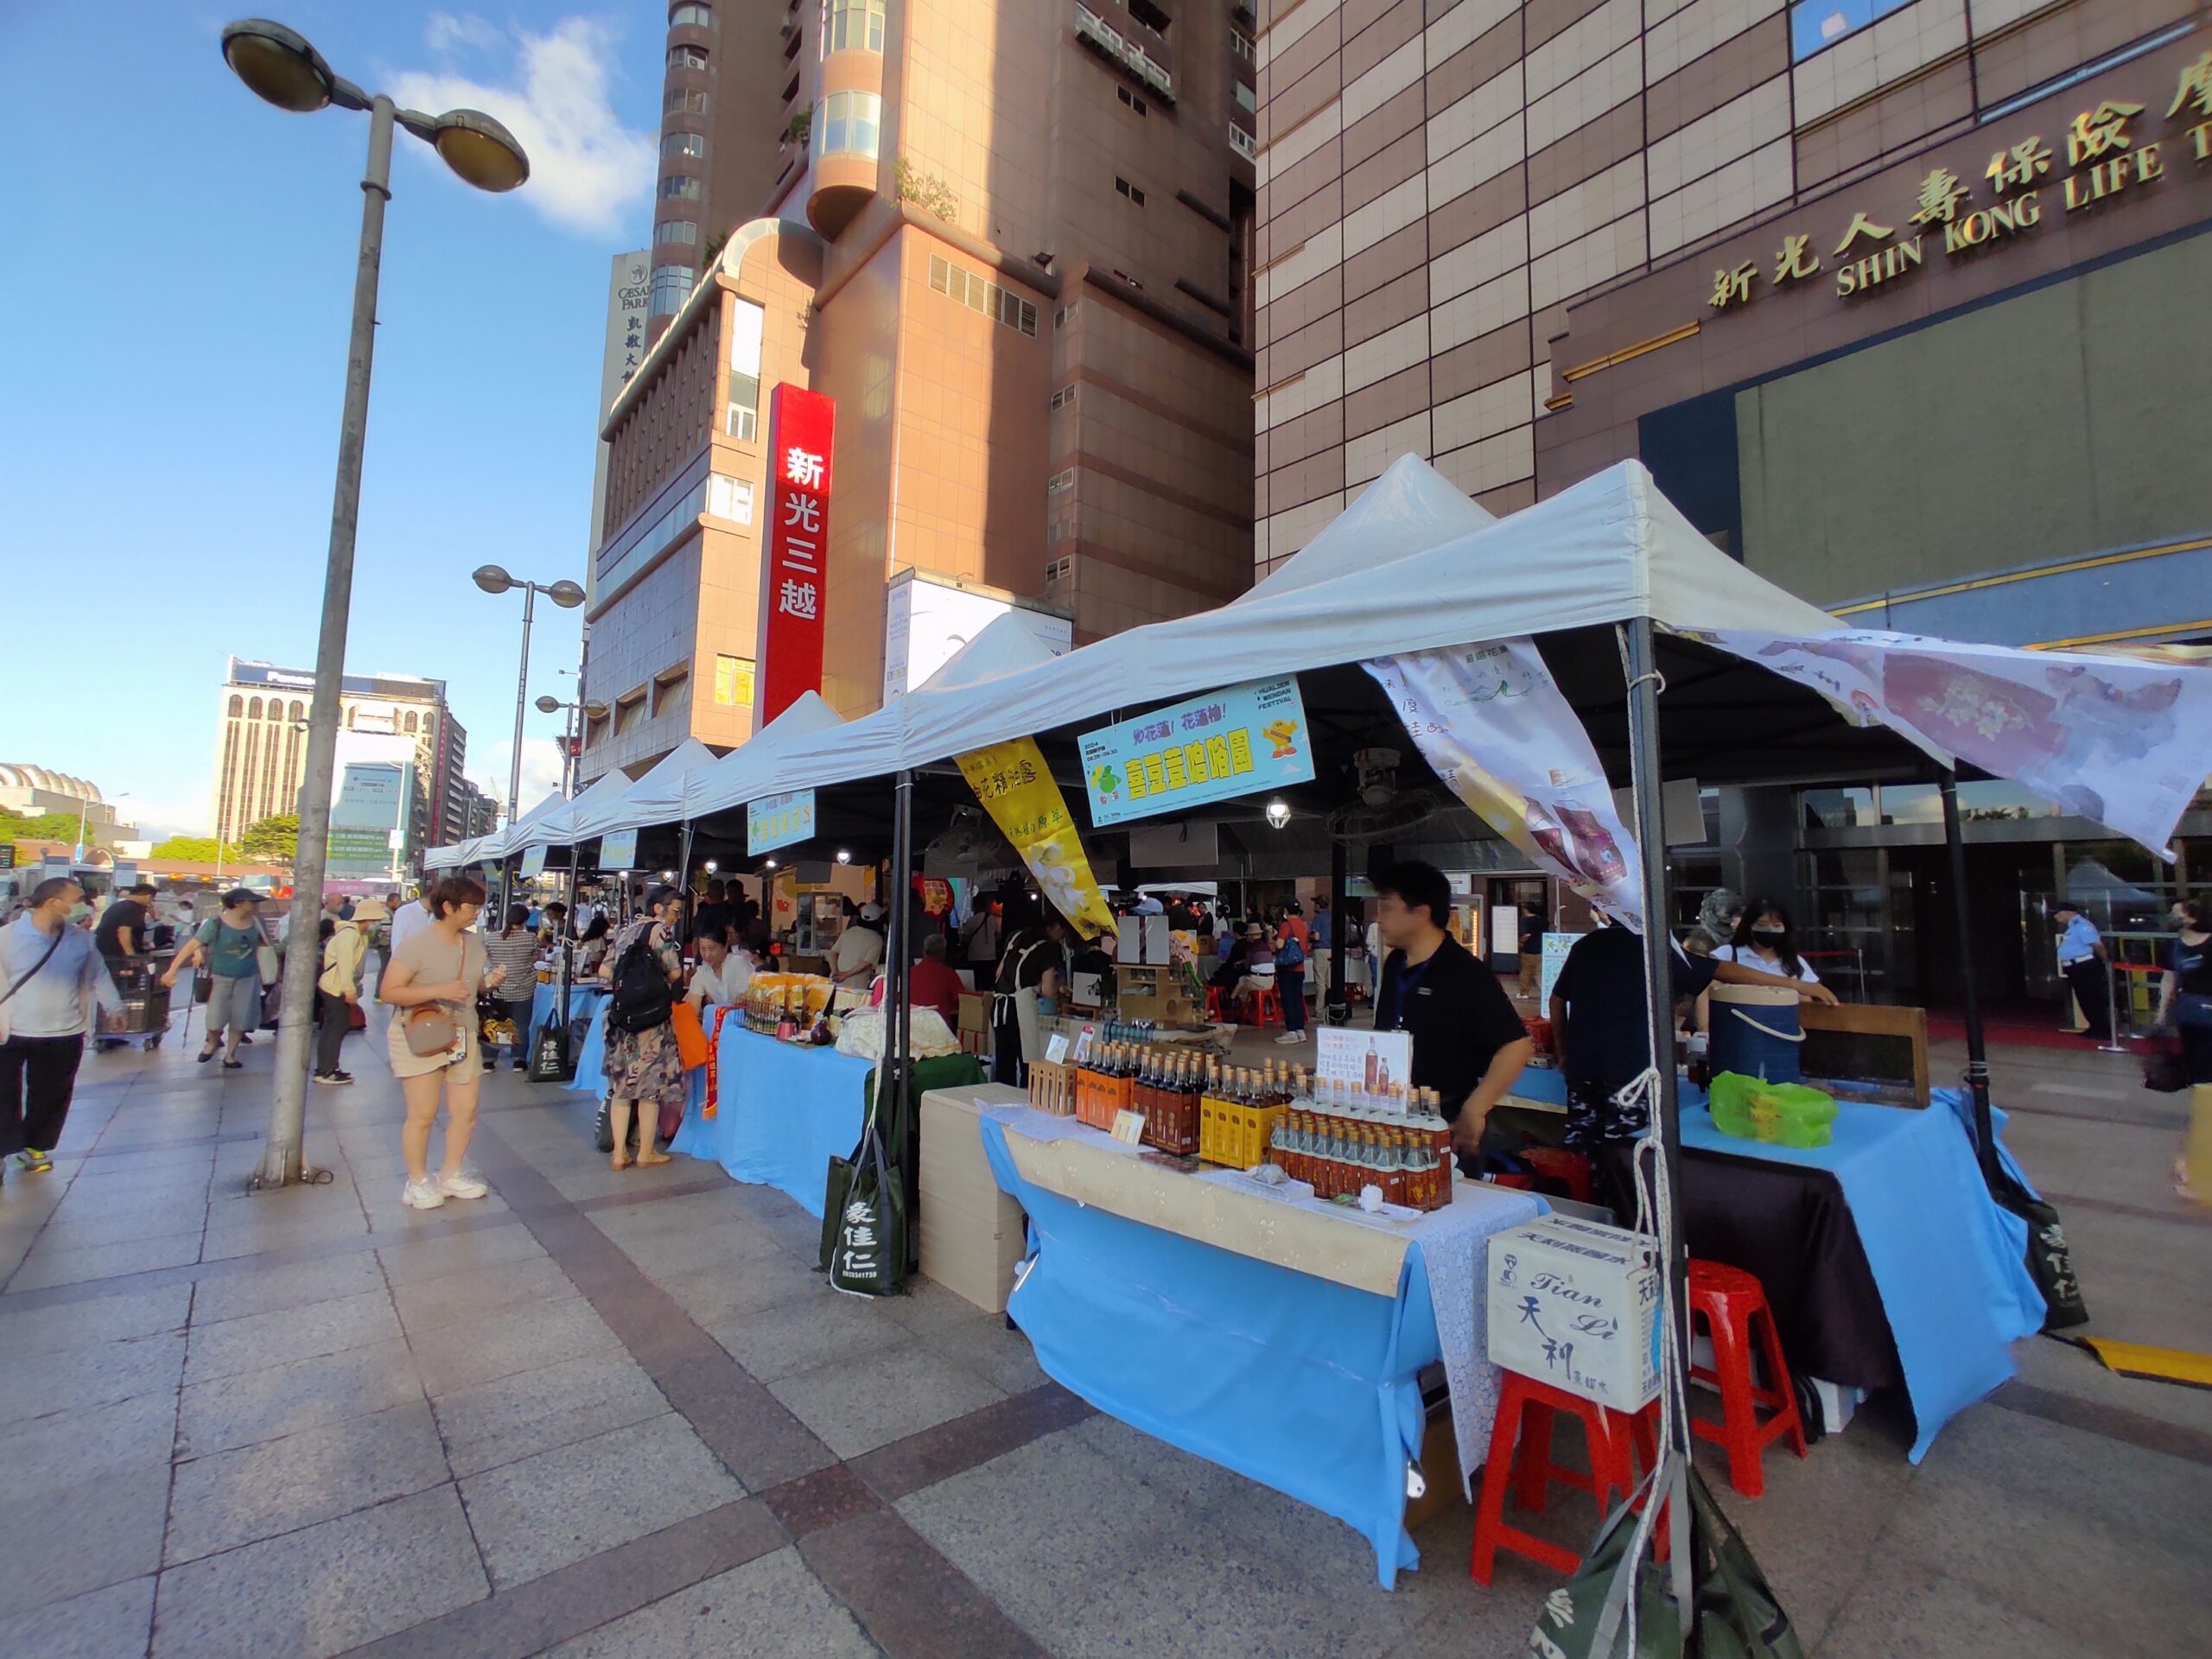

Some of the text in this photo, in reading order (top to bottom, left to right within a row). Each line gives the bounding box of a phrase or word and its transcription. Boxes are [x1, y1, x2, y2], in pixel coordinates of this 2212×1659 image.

[1837, 234, 1923, 297] SHIN
[1944, 191, 2041, 254] KONG
[2063, 143, 2164, 211] LIFE
[779, 447, 824, 620] 新光三越
[1258, 696, 1292, 710] FESTIVAL
[1530, 1272, 1604, 1309] Tian
[1570, 1313, 1618, 1340] Li
